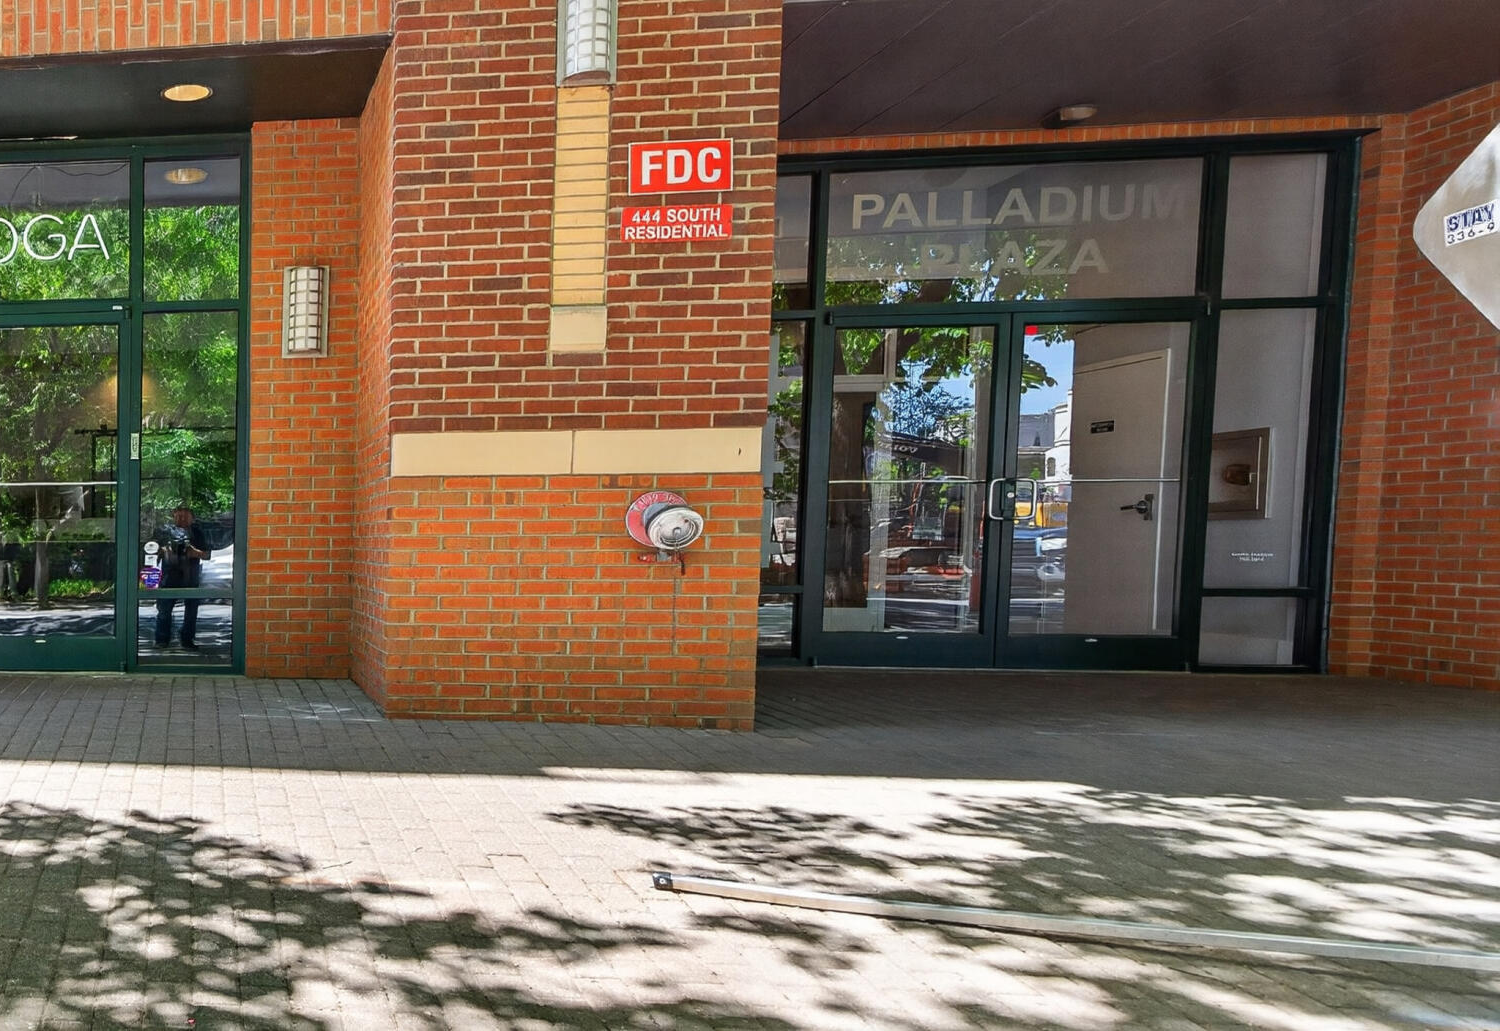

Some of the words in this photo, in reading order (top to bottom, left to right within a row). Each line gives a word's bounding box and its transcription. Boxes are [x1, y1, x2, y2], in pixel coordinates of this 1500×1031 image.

[640, 146, 722, 186] FDC
[631, 209, 661, 224] 444
[666, 207, 721, 223] SOUTH
[851, 183, 1187, 231] PALLADIUM
[624, 223, 729, 241] RESIDENTIAL
[918, 238, 1110, 277] PLAZA
